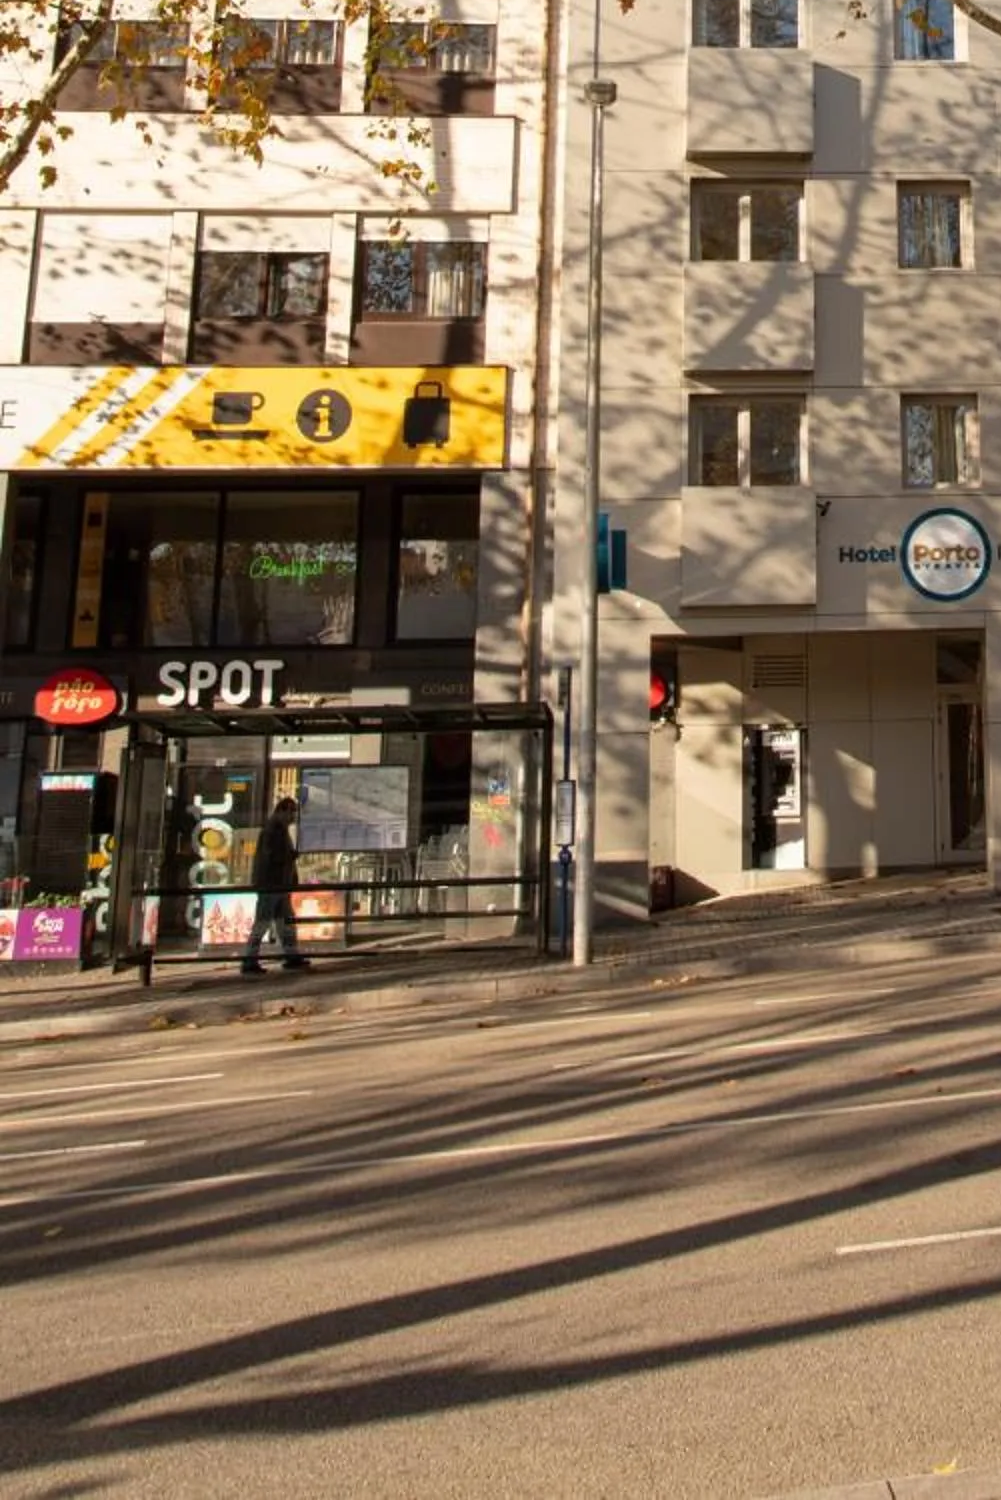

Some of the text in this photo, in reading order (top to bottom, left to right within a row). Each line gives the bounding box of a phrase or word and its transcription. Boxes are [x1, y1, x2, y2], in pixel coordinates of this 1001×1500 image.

[838, 545, 897, 564] Hotel
[913, 543, 980, 562] Porto
[53, 677, 95, 697] pão
[157, 660, 285, 707] SPOT
